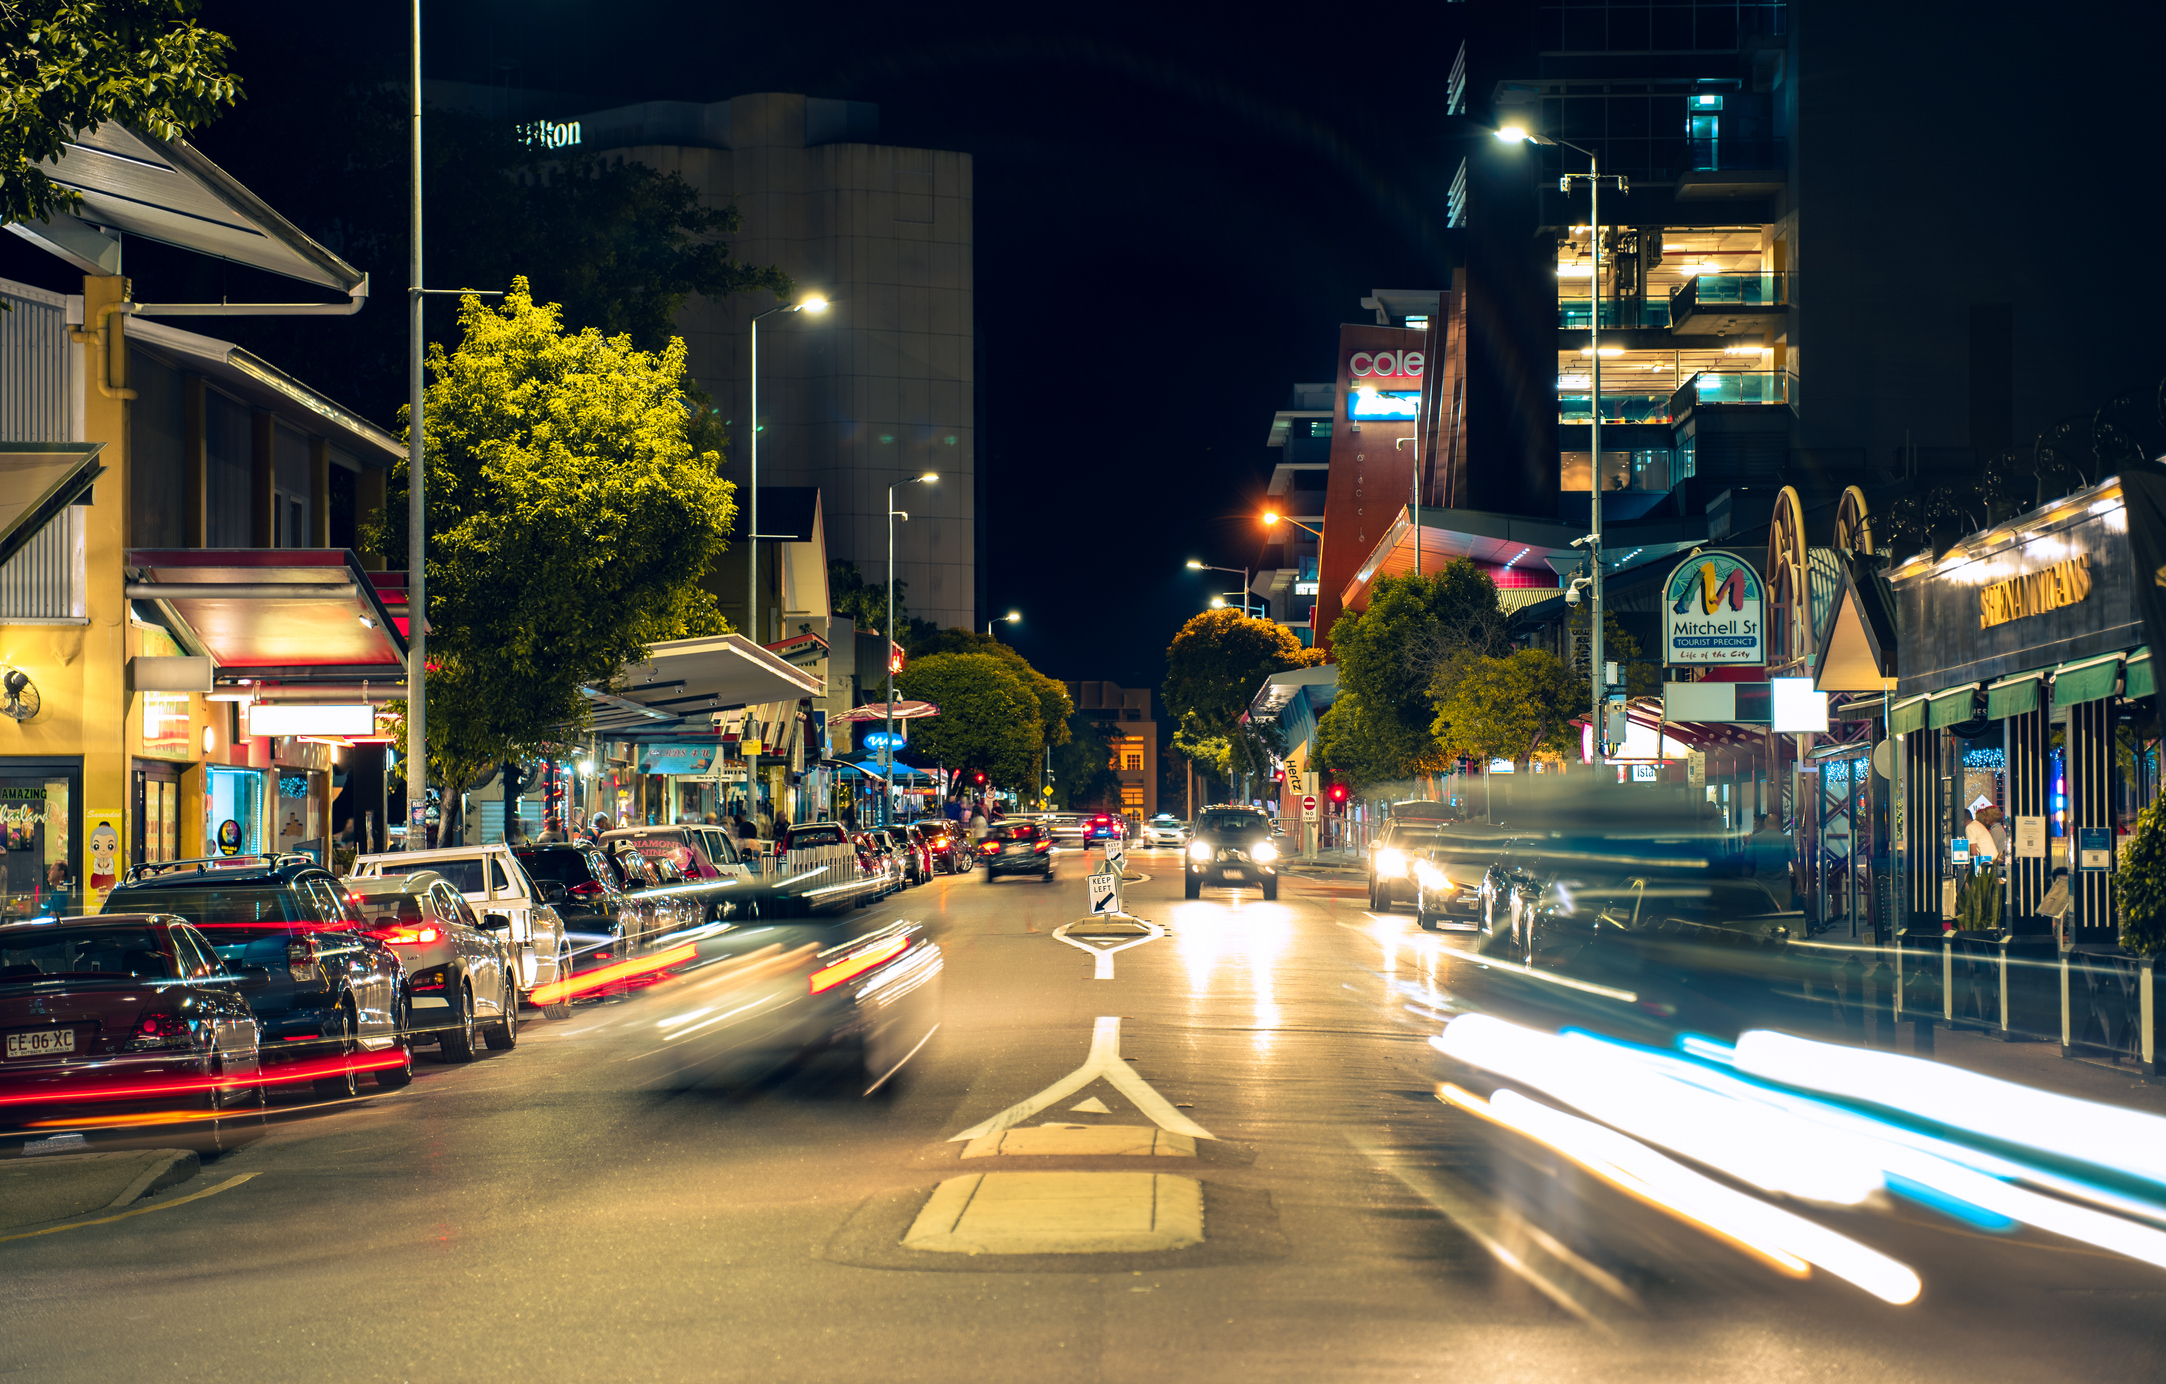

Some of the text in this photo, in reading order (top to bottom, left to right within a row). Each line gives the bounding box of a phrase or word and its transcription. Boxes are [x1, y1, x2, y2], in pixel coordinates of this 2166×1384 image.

[515, 119, 582, 151] lton
[1350, 350, 1424, 376] cole
[1674, 620, 1757, 635] Mitchell St
[1680, 651, 1697, 660] Life
[1701, 652, 1708, 660] of
[1731, 651, 1750, 659] City
[649, 748, 711, 758] CARDS 4 U
[1286, 760, 1302, 791] Hertz
[1637, 767, 1657, 778] Ista
[1, 788, 47, 800] AMAZING
[0, 803, 51, 824] hailand
[632, 840, 684, 850] DIAMOND
[1092, 876, 1111, 885] KEEP
[1093, 885, 1111, 893] LEFT
